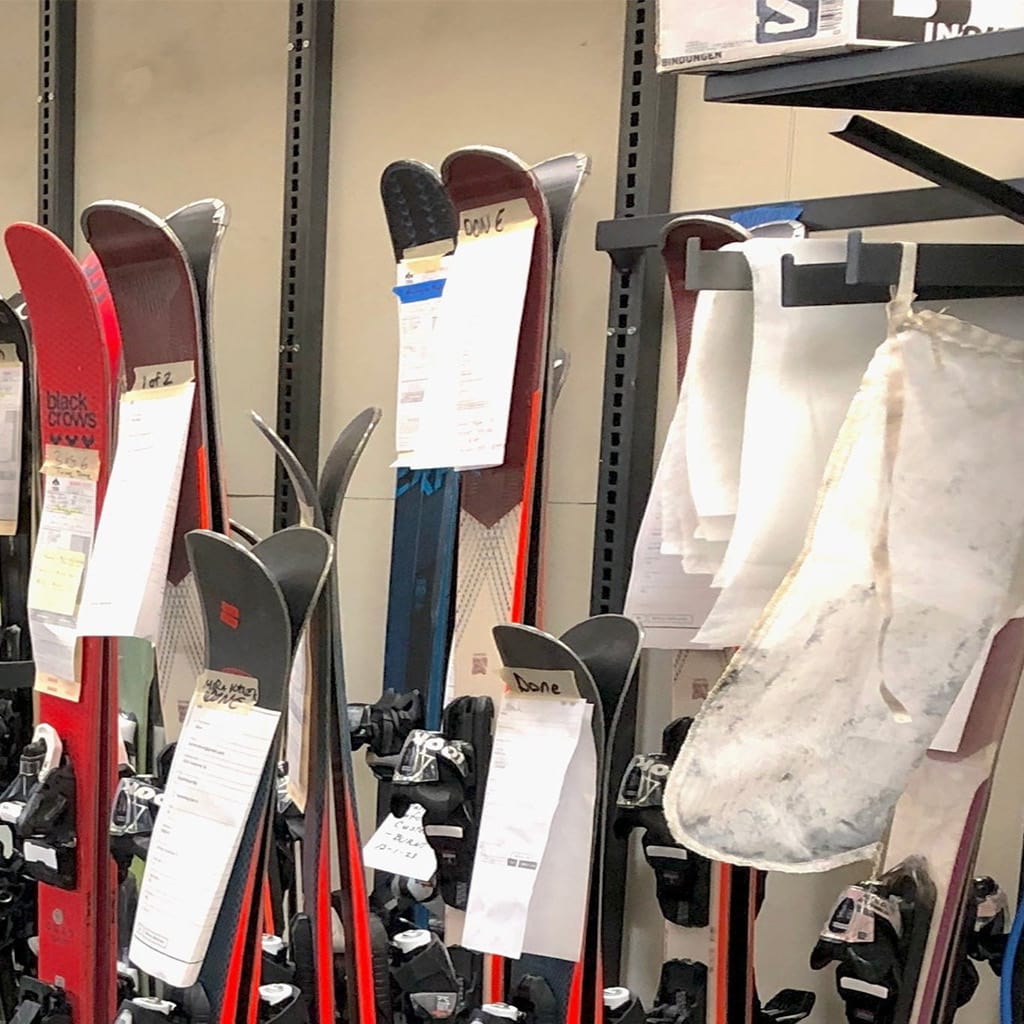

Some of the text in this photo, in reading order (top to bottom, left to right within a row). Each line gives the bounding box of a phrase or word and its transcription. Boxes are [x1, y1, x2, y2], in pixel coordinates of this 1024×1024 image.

[149, 371, 161, 388] of
[163, 371, 174, 386] 2
[46, 391, 87, 411] black
[48, 411, 97, 428] crows
[513, 672, 562, 694] Done
